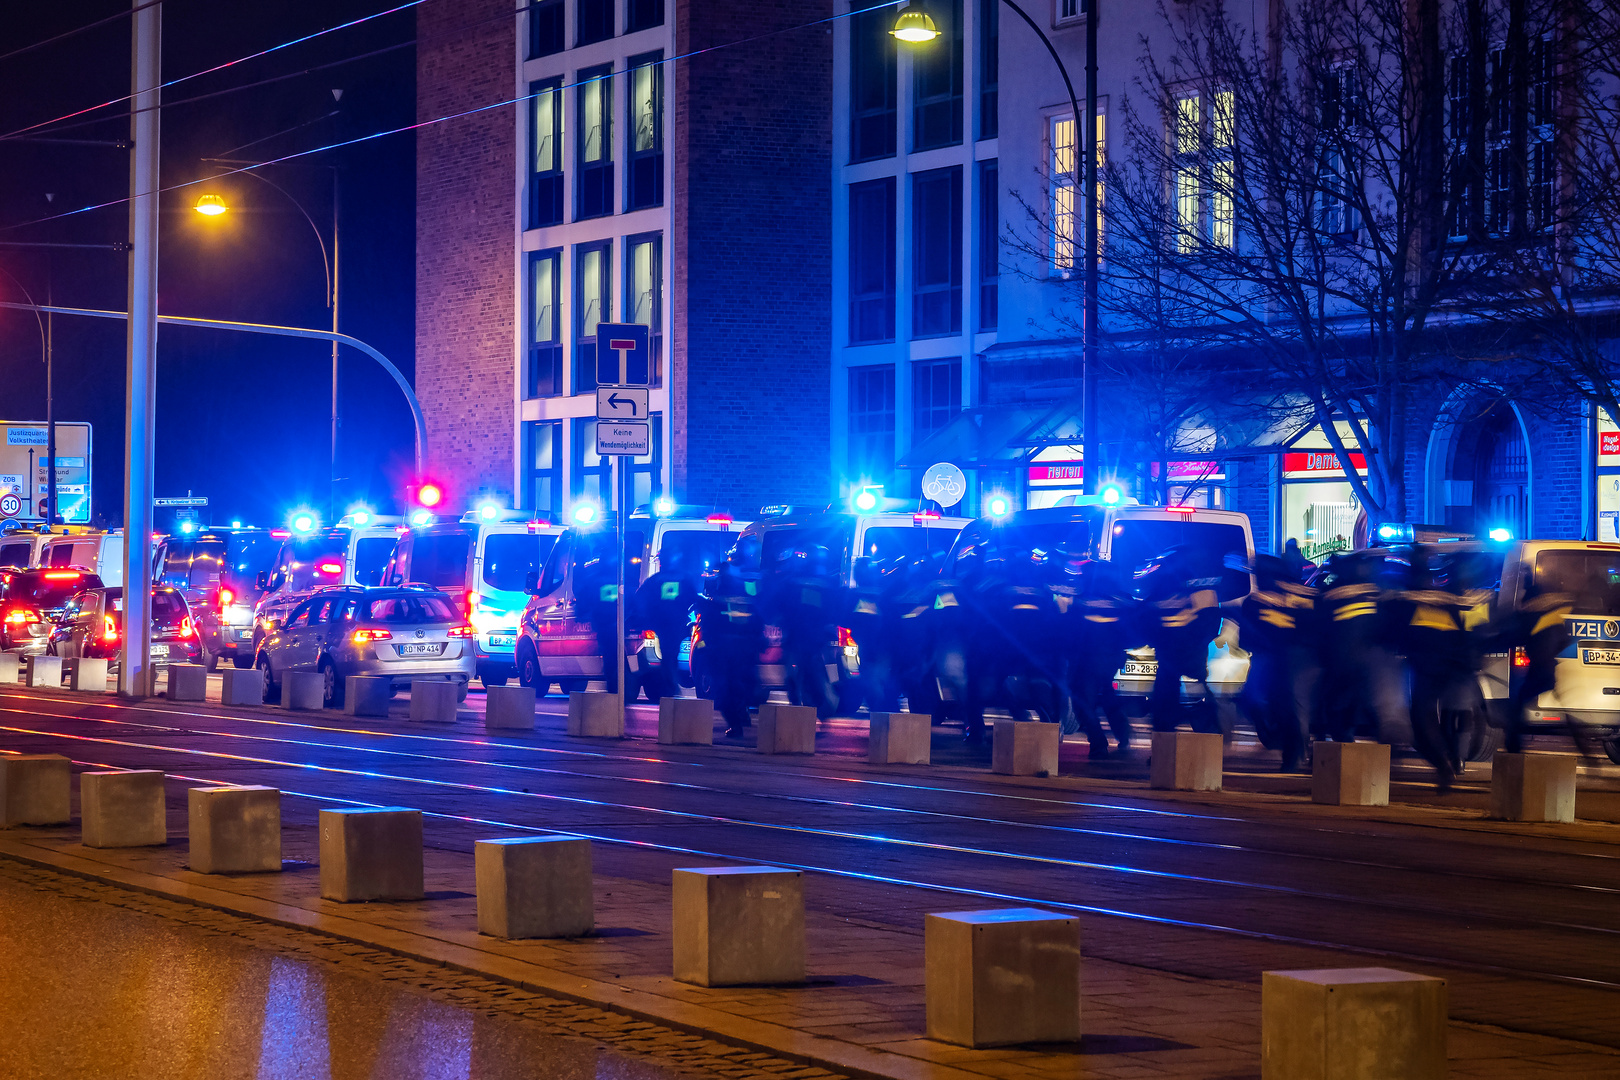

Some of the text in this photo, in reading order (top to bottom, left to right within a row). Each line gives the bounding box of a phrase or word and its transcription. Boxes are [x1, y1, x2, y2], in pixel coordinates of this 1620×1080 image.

[600, 441, 646, 450] Wendemöglichkeit
[1307, 452, 1344, 470] Dame
[1047, 465, 1081, 479] Herren
[4, 500, 17, 511] 30
[1589, 652, 1620, 662] BP 34-
[1126, 665, 1136, 673] BP
